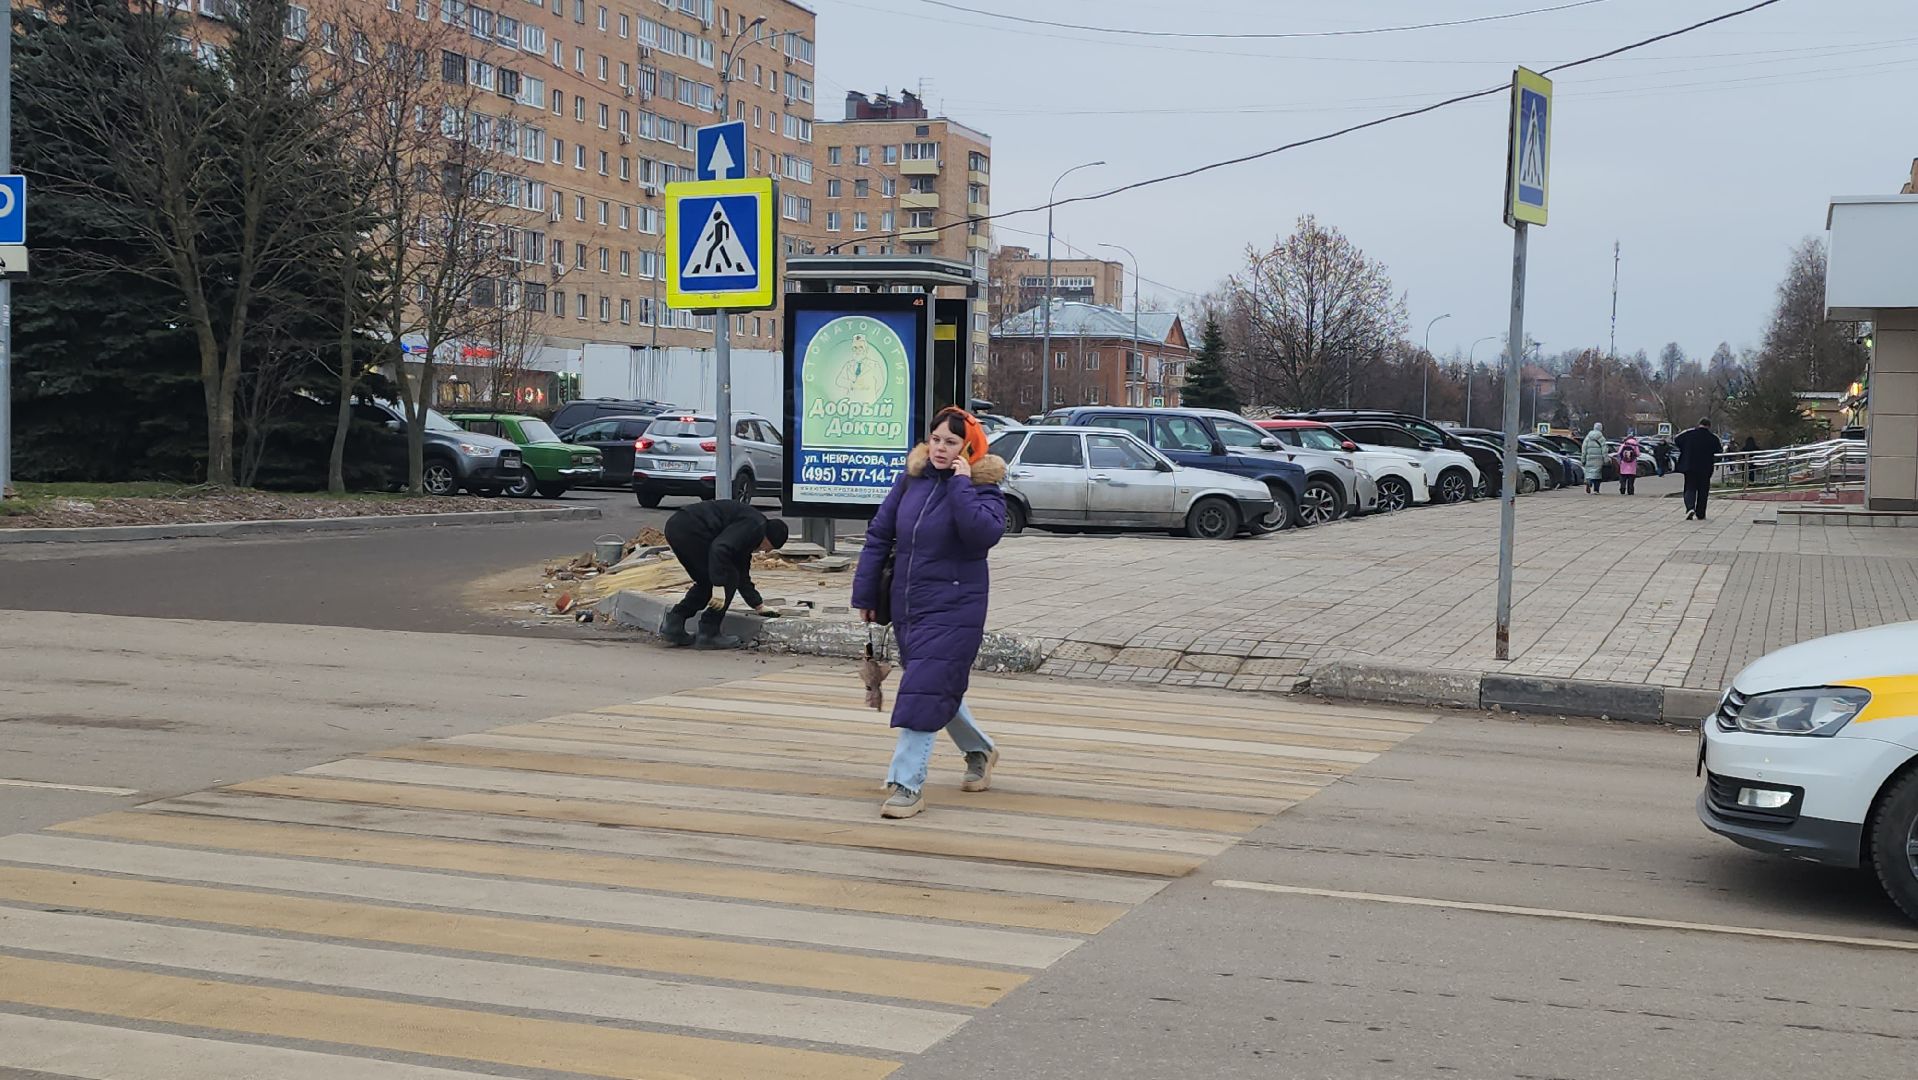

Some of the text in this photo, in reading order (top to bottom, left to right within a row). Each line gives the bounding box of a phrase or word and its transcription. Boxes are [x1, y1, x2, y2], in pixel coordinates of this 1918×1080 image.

[805, 320, 905, 385] СТОМАТОЛОГИЯ
[808, 397, 894, 420] Добрый
[824, 417, 902, 440] Доктор
[804, 454, 819, 465] ул.
[822, 453, 889, 467] НЕКРАСОВА,
[801, 465, 836, 482] (495)
